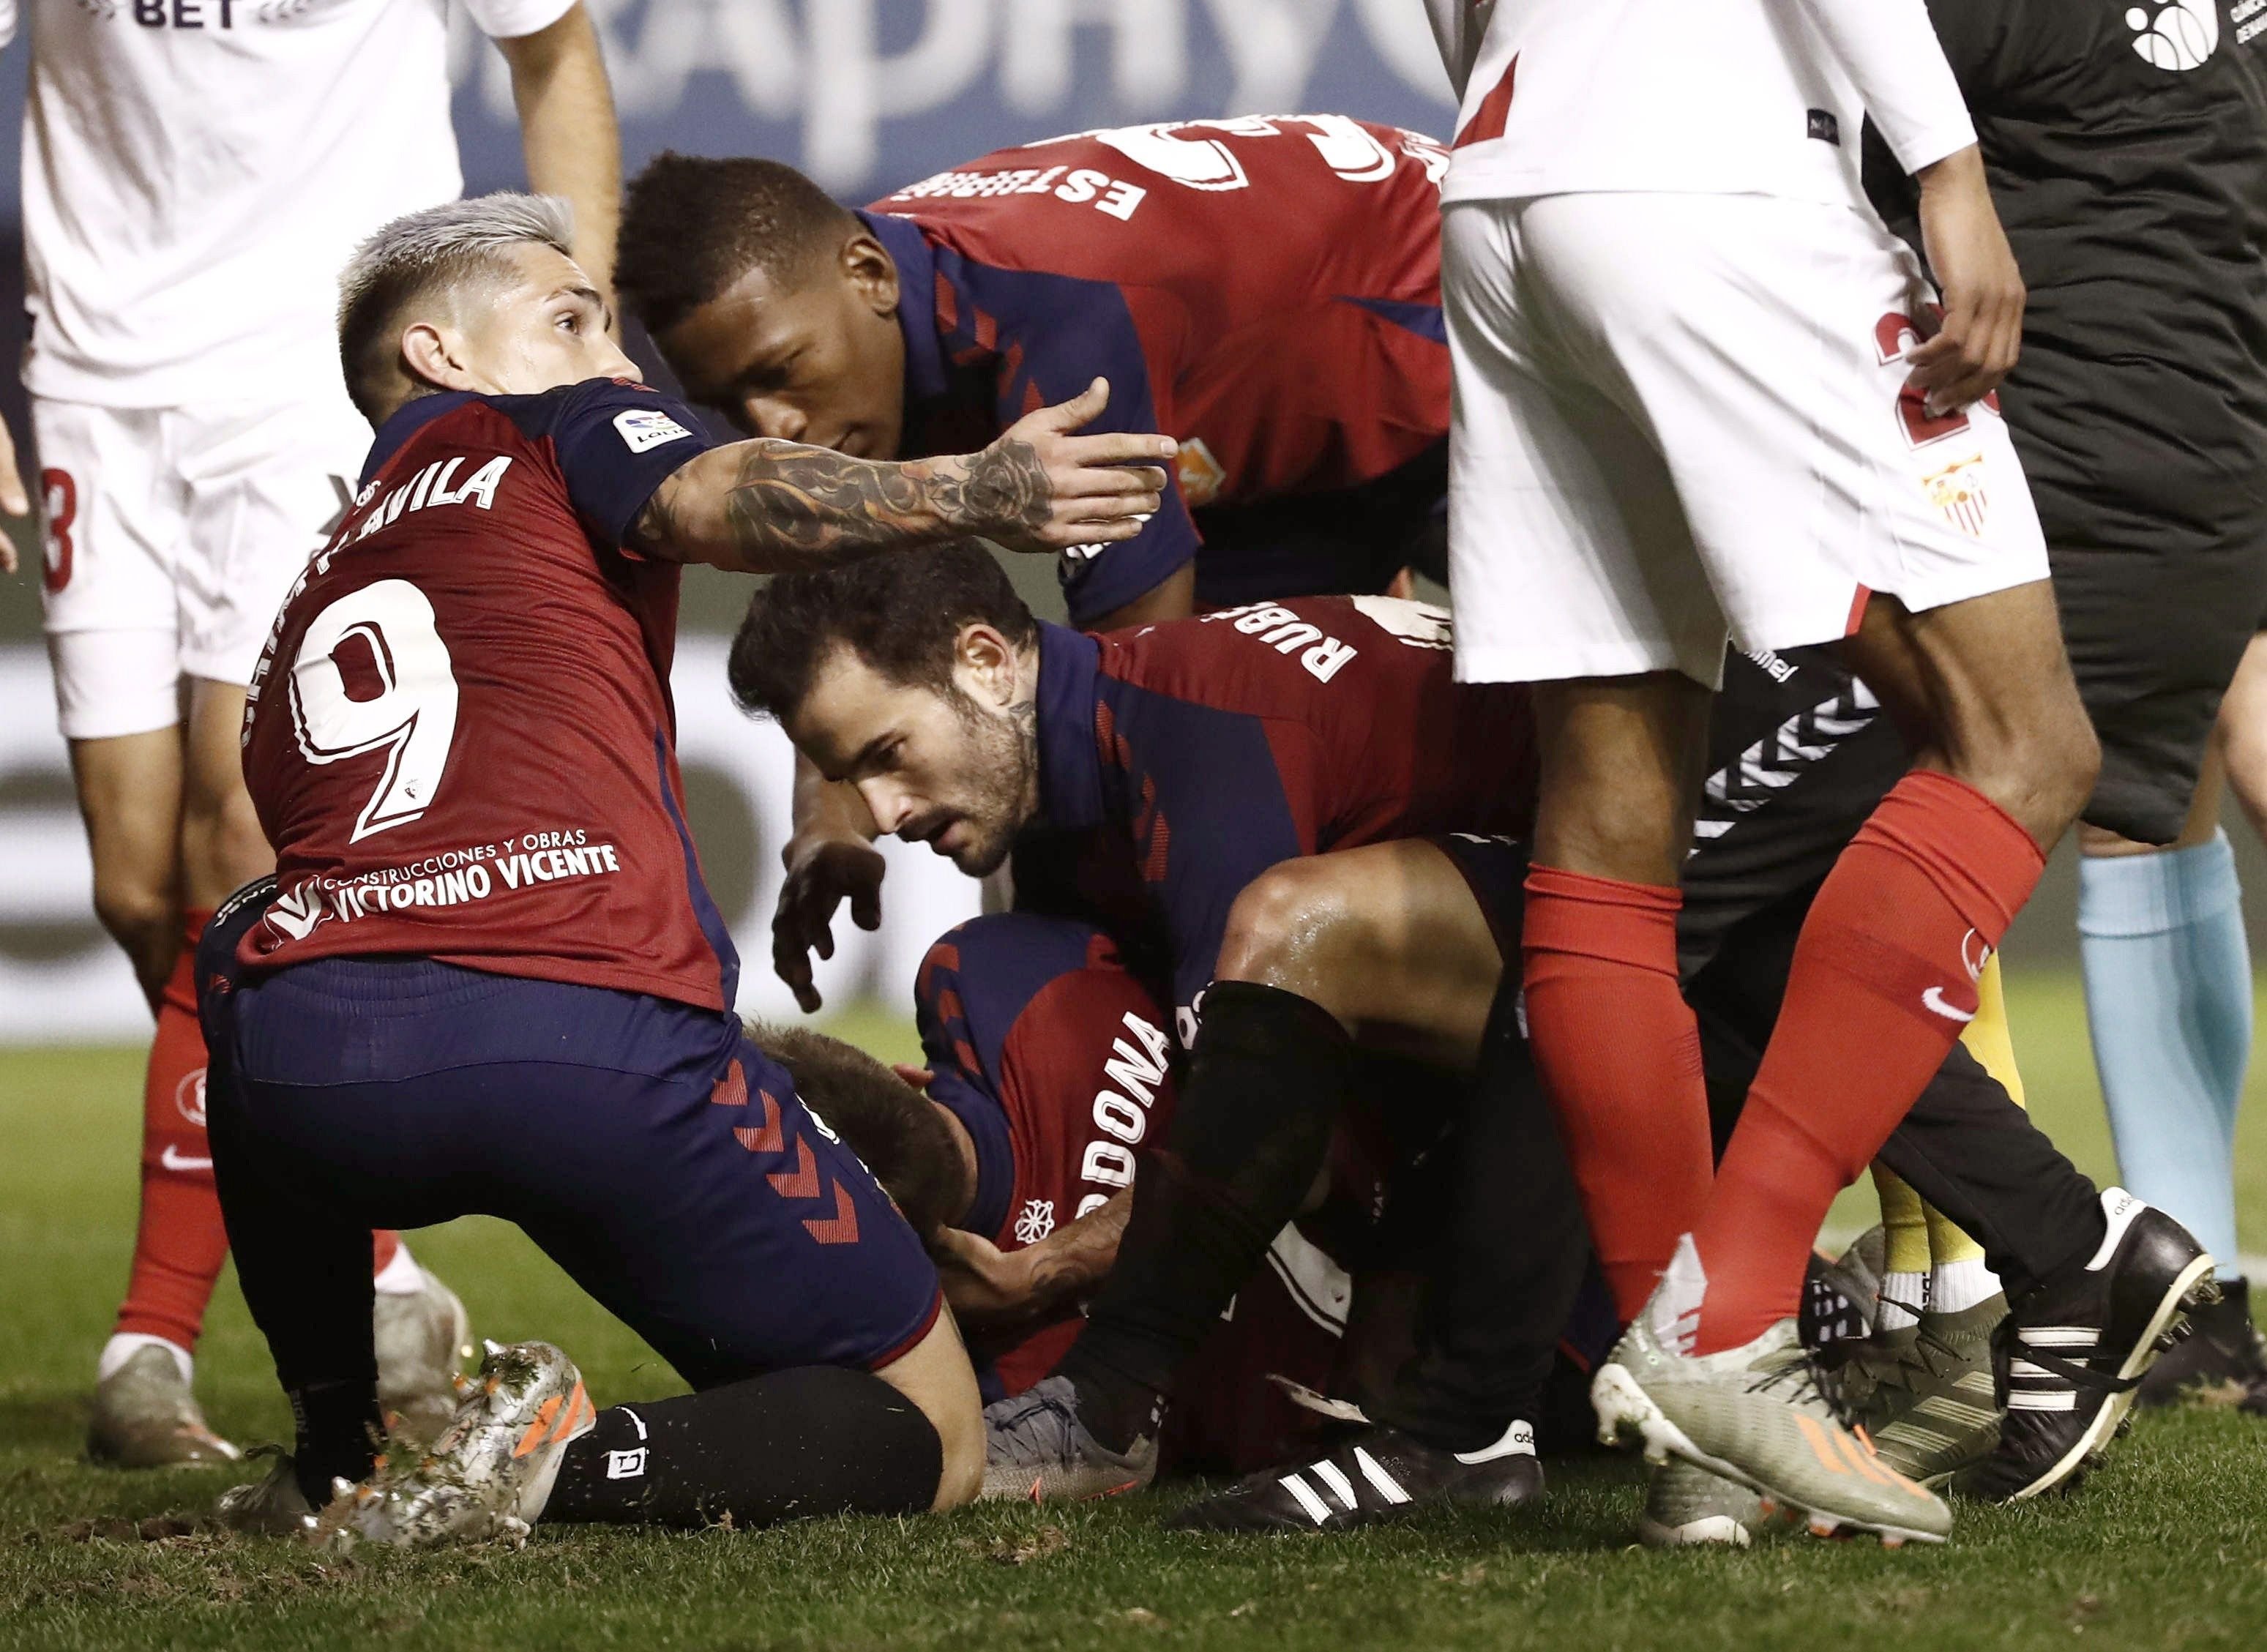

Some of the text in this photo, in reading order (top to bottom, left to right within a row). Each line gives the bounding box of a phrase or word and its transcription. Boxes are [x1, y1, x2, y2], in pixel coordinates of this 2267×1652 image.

[134, 0, 243, 29] BET
[288, 578, 460, 845] 9
[323, 828, 587, 891] CONSTRUCCIONES Y OBRAS
[328, 864, 492, 923] VICTORINO
[495, 844, 620, 890] VICENTE
